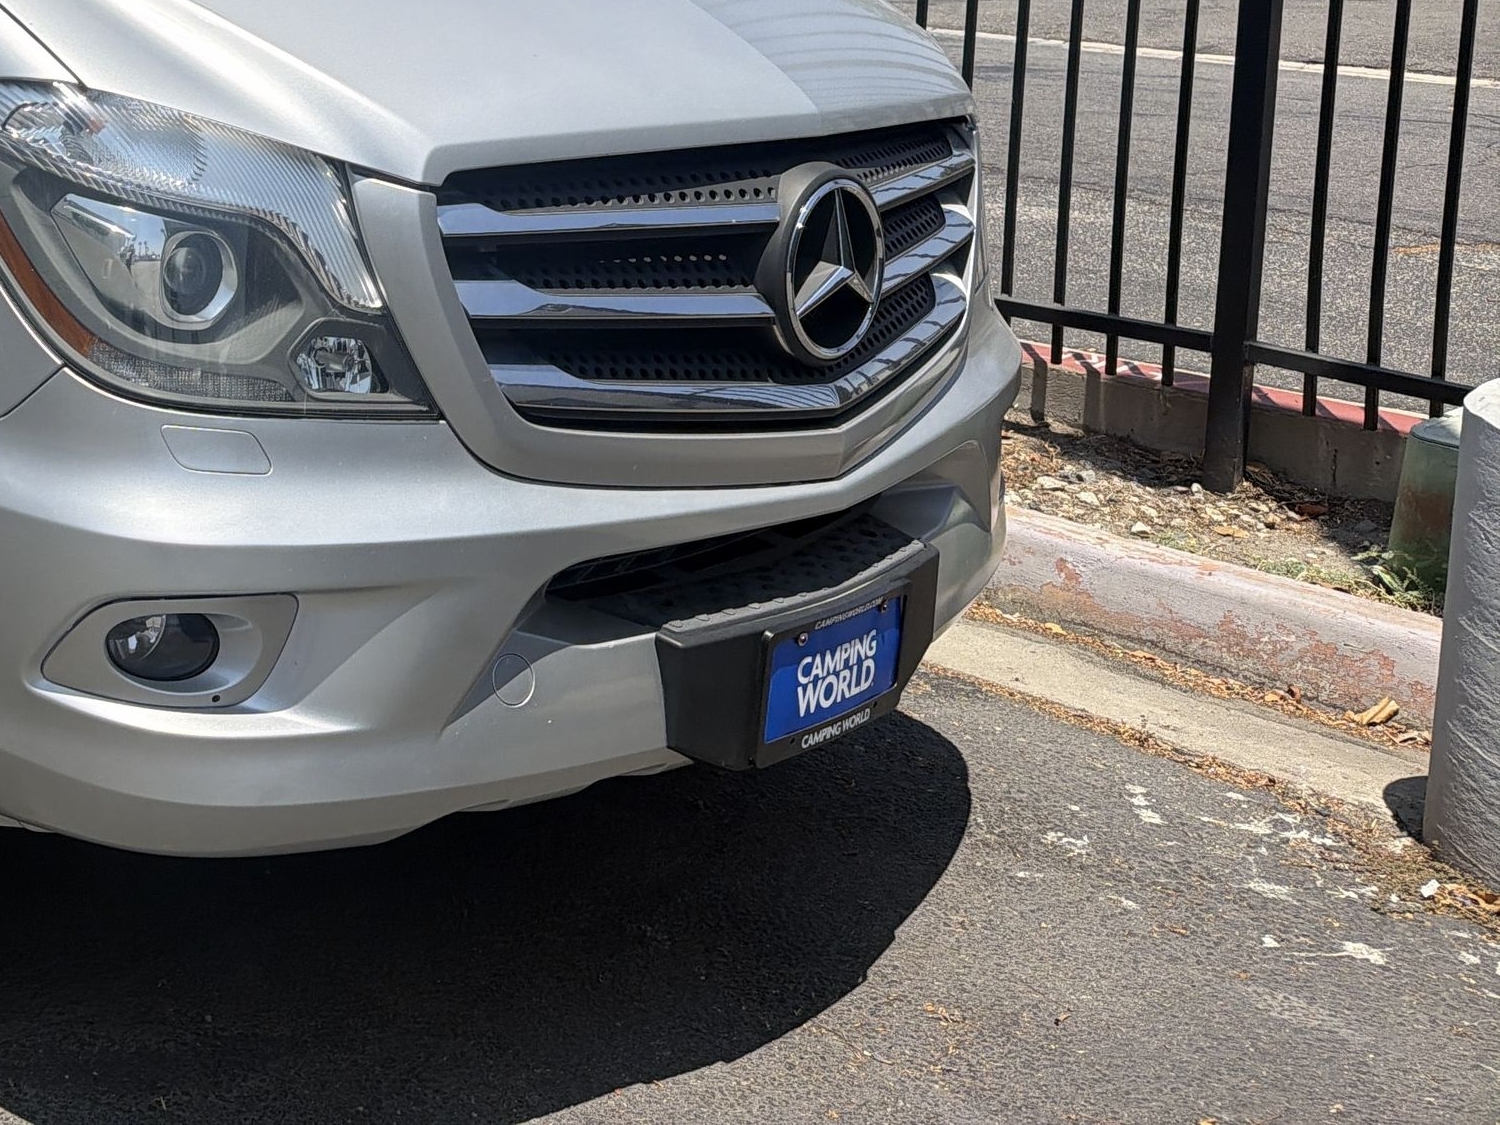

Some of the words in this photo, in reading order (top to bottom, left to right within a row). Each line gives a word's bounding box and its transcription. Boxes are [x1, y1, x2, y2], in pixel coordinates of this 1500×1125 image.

[797, 629, 877, 685] CAMPING
[797, 658, 875, 717] WORLD
[801, 722, 842, 749] CAMPING
[842, 708, 871, 732] WORLD
